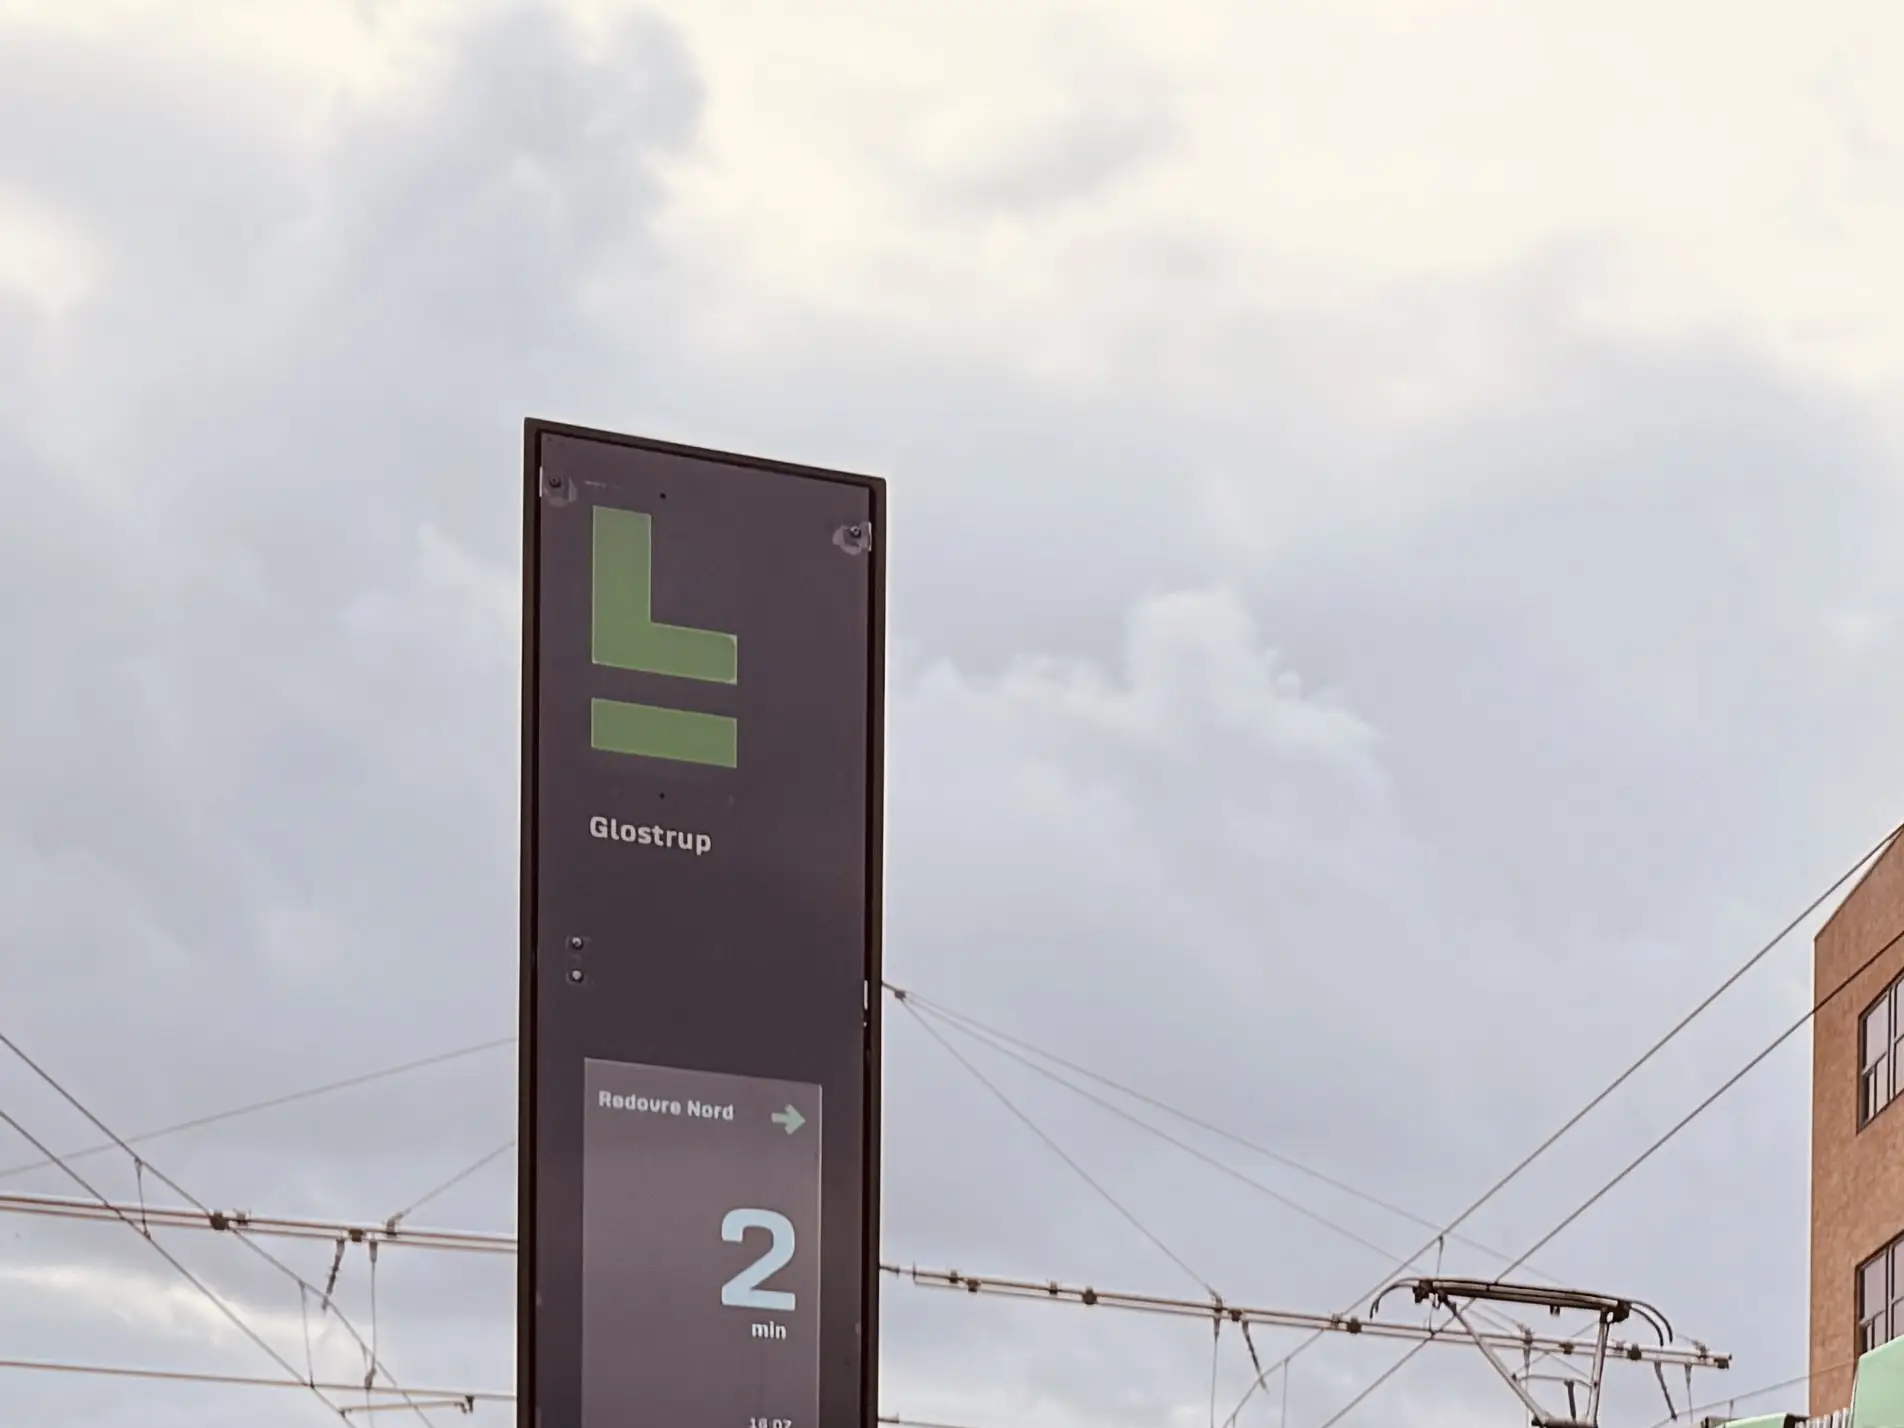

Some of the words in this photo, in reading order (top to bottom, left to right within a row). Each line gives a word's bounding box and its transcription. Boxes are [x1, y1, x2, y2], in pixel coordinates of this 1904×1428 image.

[589, 815, 713, 856] Glostrup
[687, 1099, 734, 1121] Nord
[721, 1207, 796, 1311] 2
[751, 1320, 787, 1341] min
